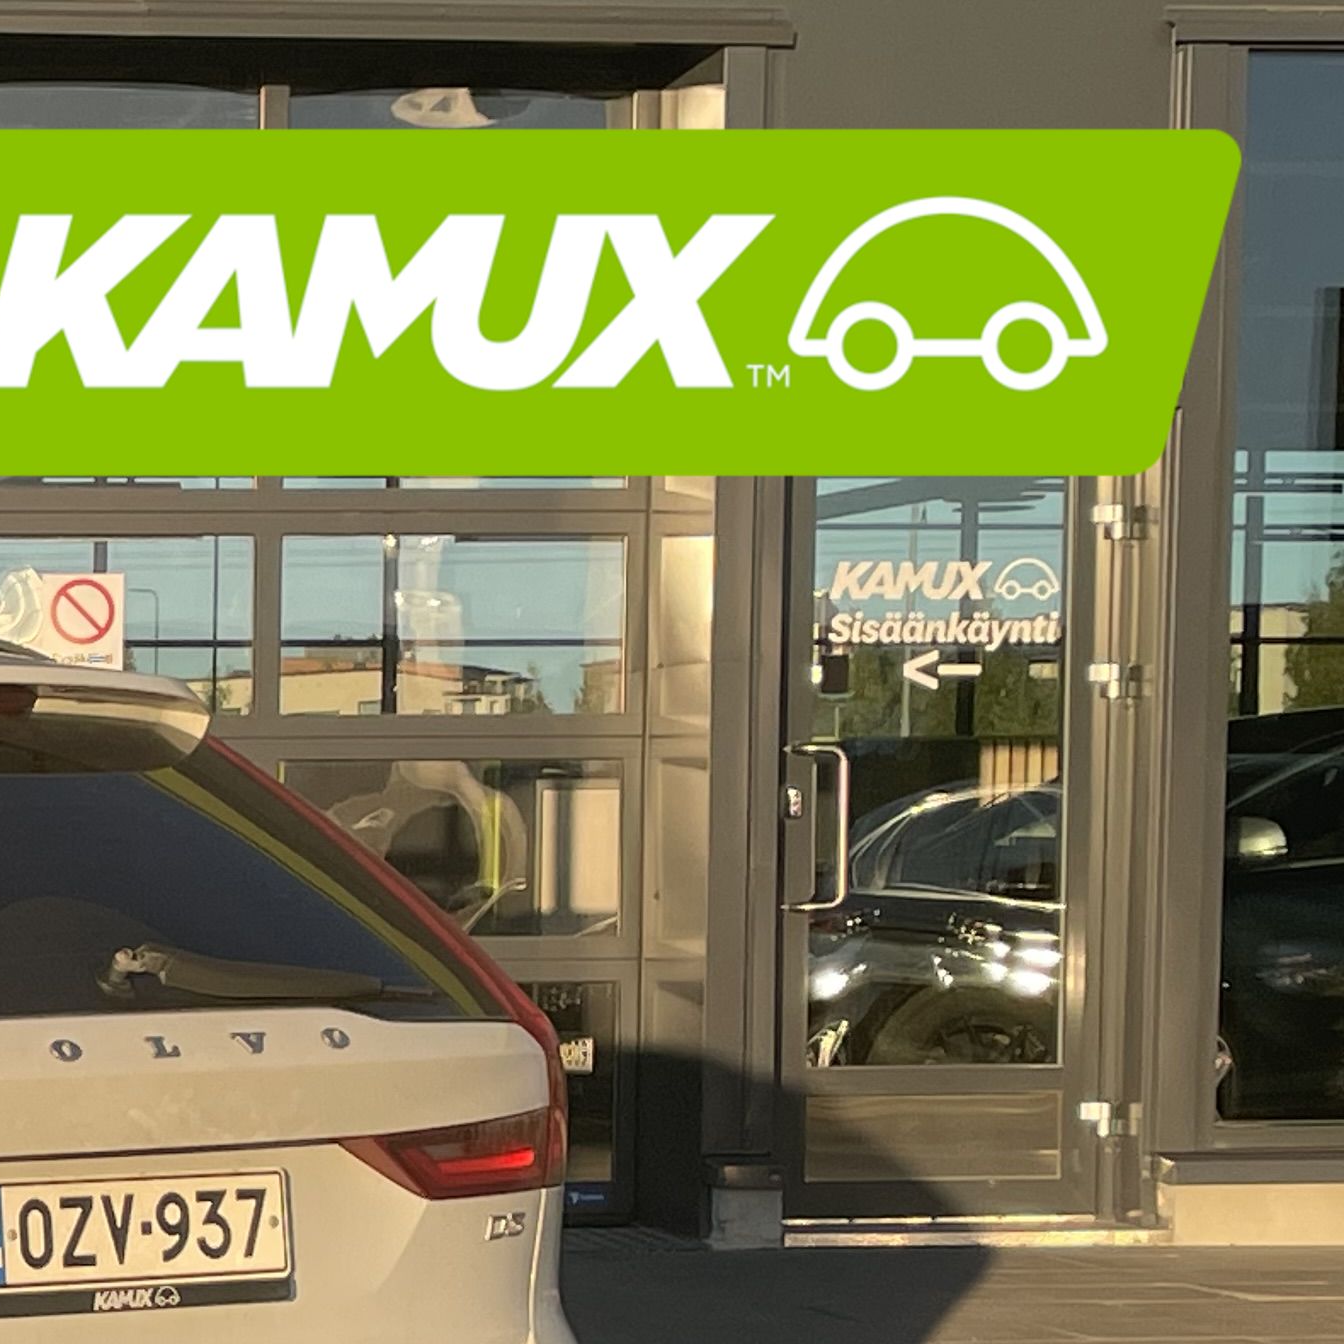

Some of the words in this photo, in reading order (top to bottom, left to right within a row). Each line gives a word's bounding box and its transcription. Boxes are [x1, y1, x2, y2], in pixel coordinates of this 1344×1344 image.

[830, 561, 993, 600] KAMUX
[828, 610, 1060, 652] Sisäänkäynti
[18, 1188, 267, 1269] OZV-937
[92, 1287, 154, 1312] KAMUX
